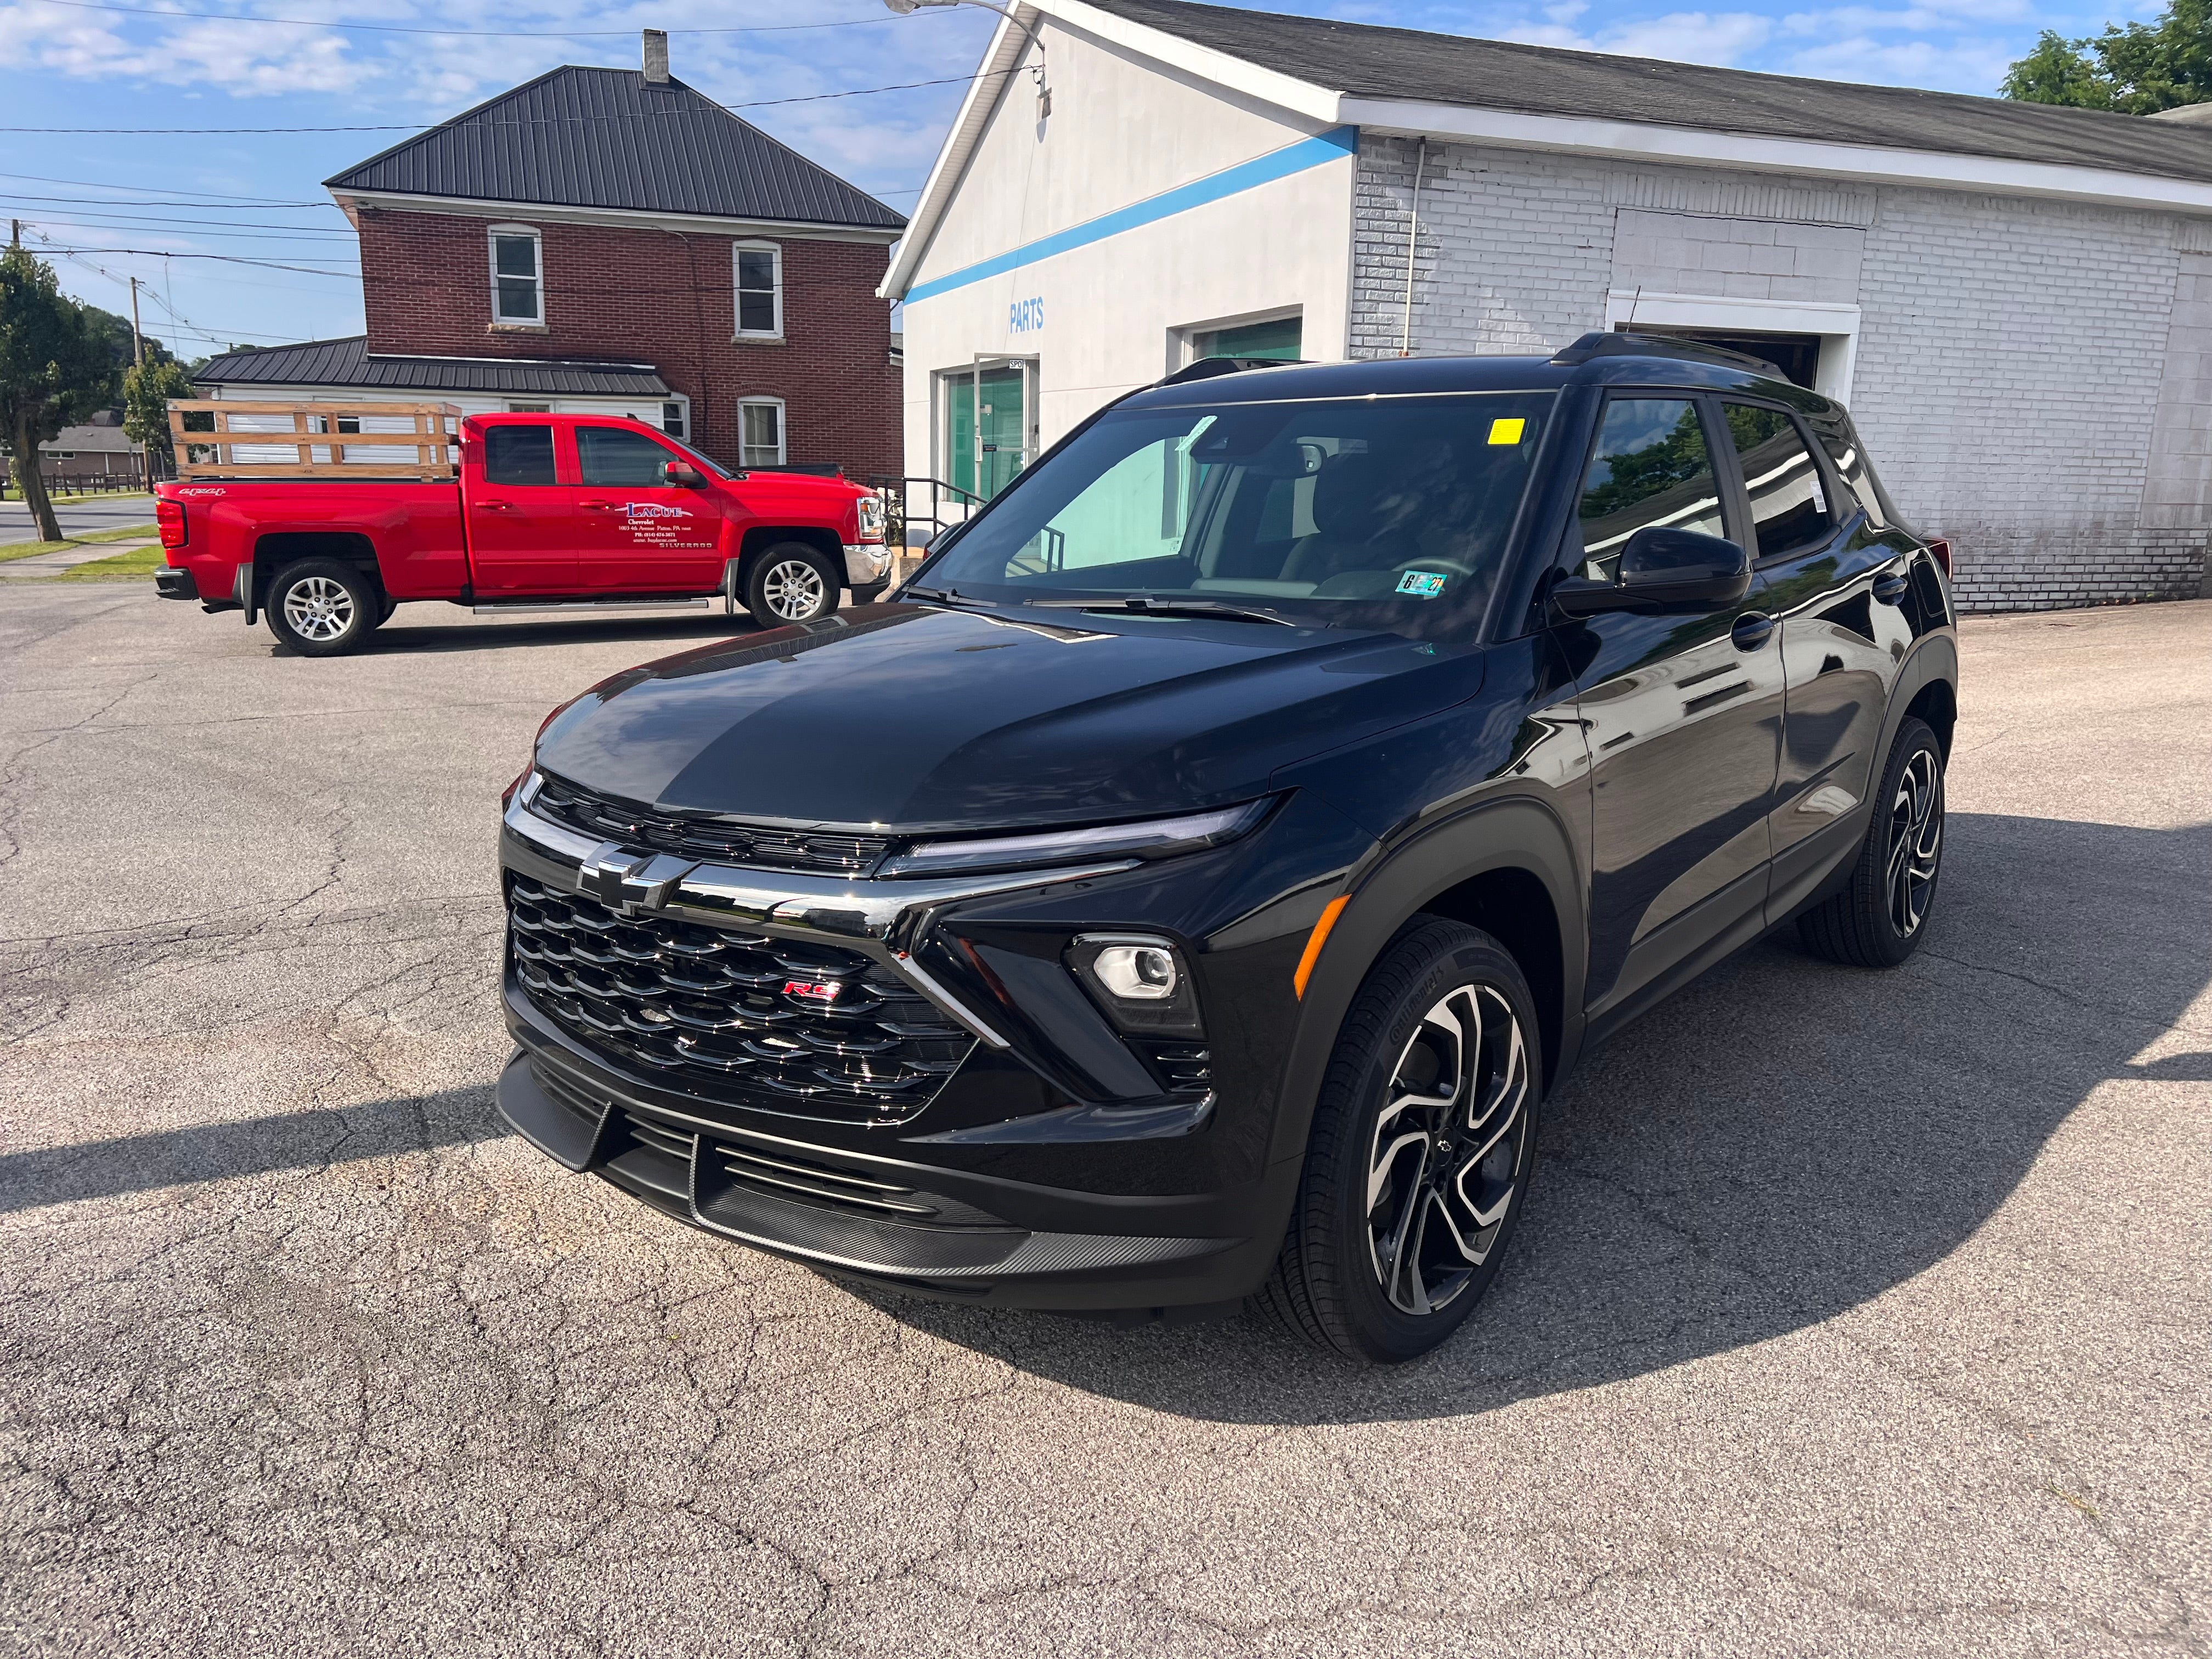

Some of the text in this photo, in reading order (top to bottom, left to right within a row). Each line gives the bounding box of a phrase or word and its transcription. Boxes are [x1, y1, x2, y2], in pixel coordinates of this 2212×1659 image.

[1010, 296, 1043, 334] PARTS
[1403, 574, 1415, 589] 6
[781, 981, 840, 1002] RS
